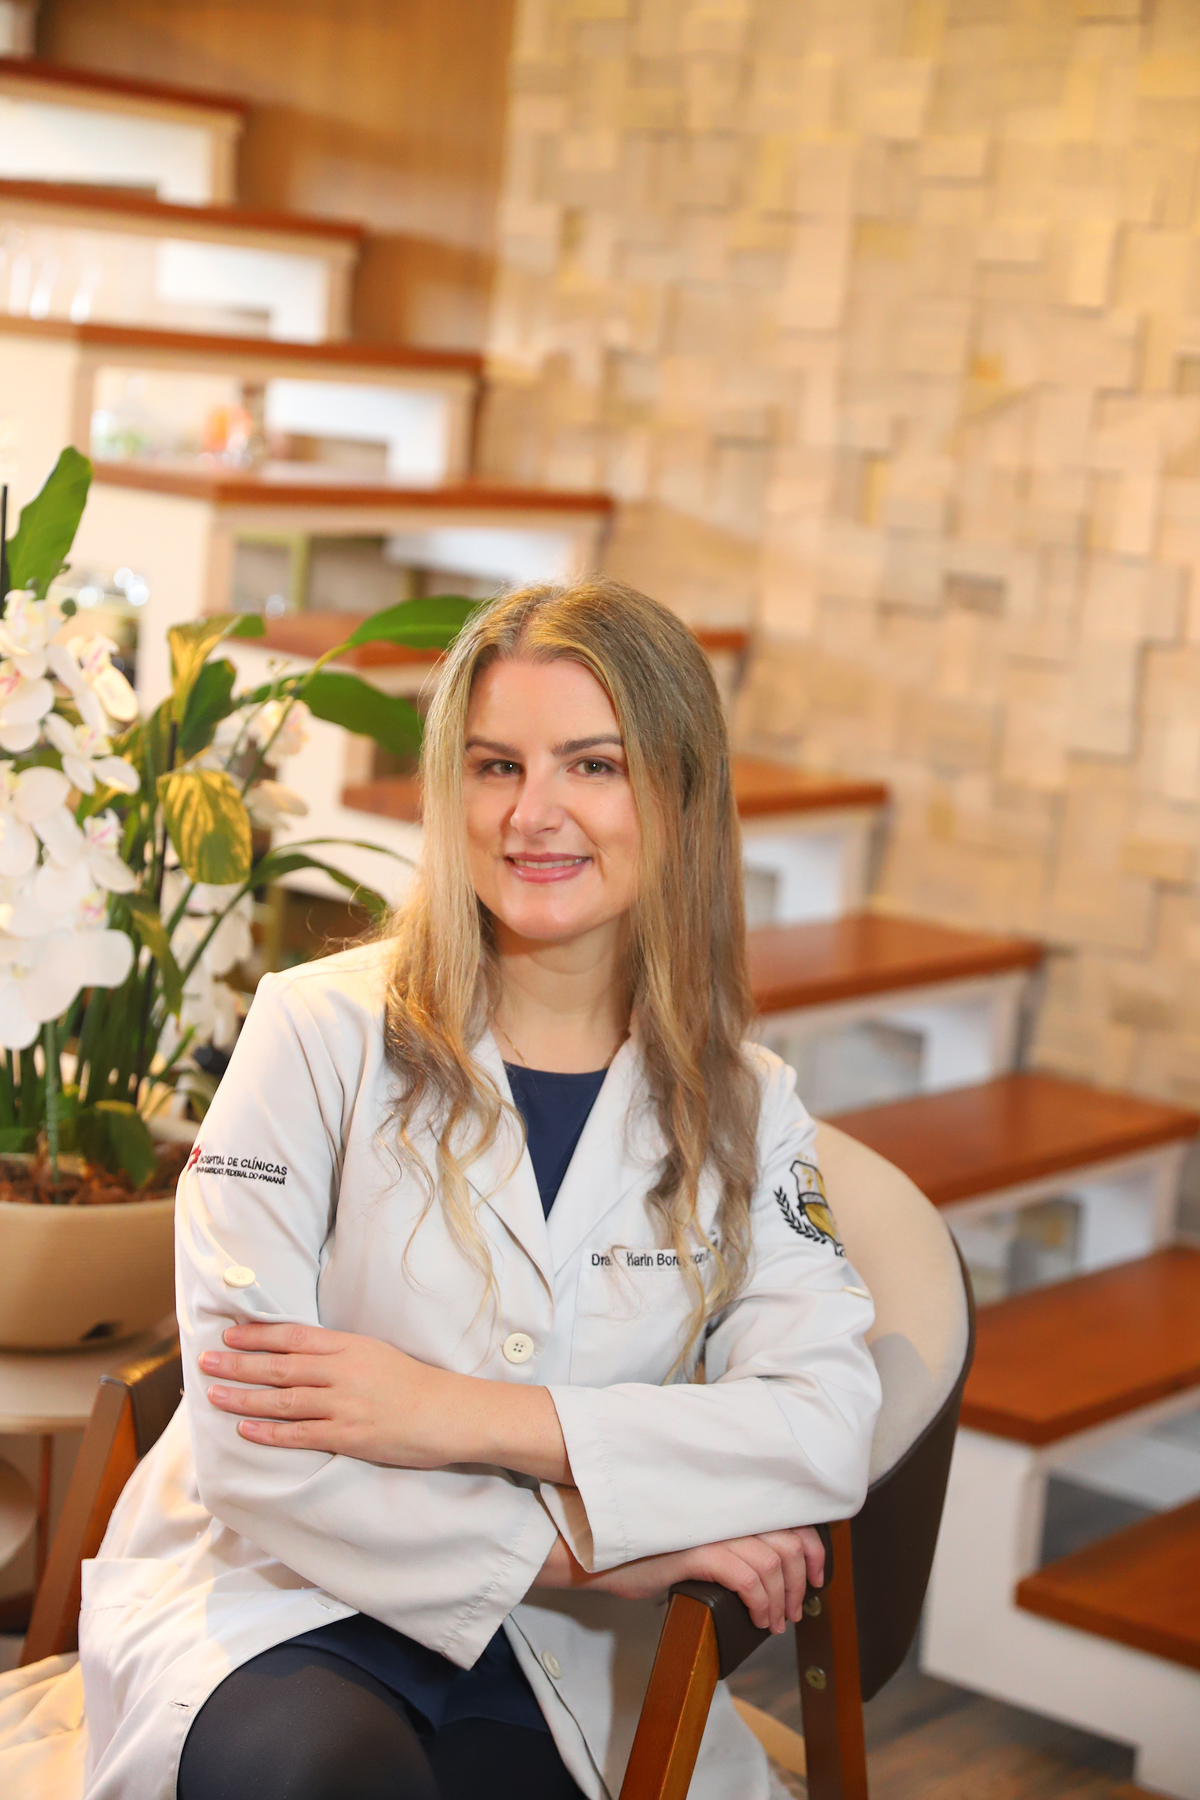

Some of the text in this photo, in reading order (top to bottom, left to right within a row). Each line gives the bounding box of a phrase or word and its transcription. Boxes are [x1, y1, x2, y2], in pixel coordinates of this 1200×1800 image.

[227, 1157, 238, 1167] DE
[241, 1156, 287, 1176] CLÍNICAS
[248, 1172, 258, 1180] DO
[258, 1174, 286, 1185] PARANÁ
[626, 1252, 654, 1266] Karin
